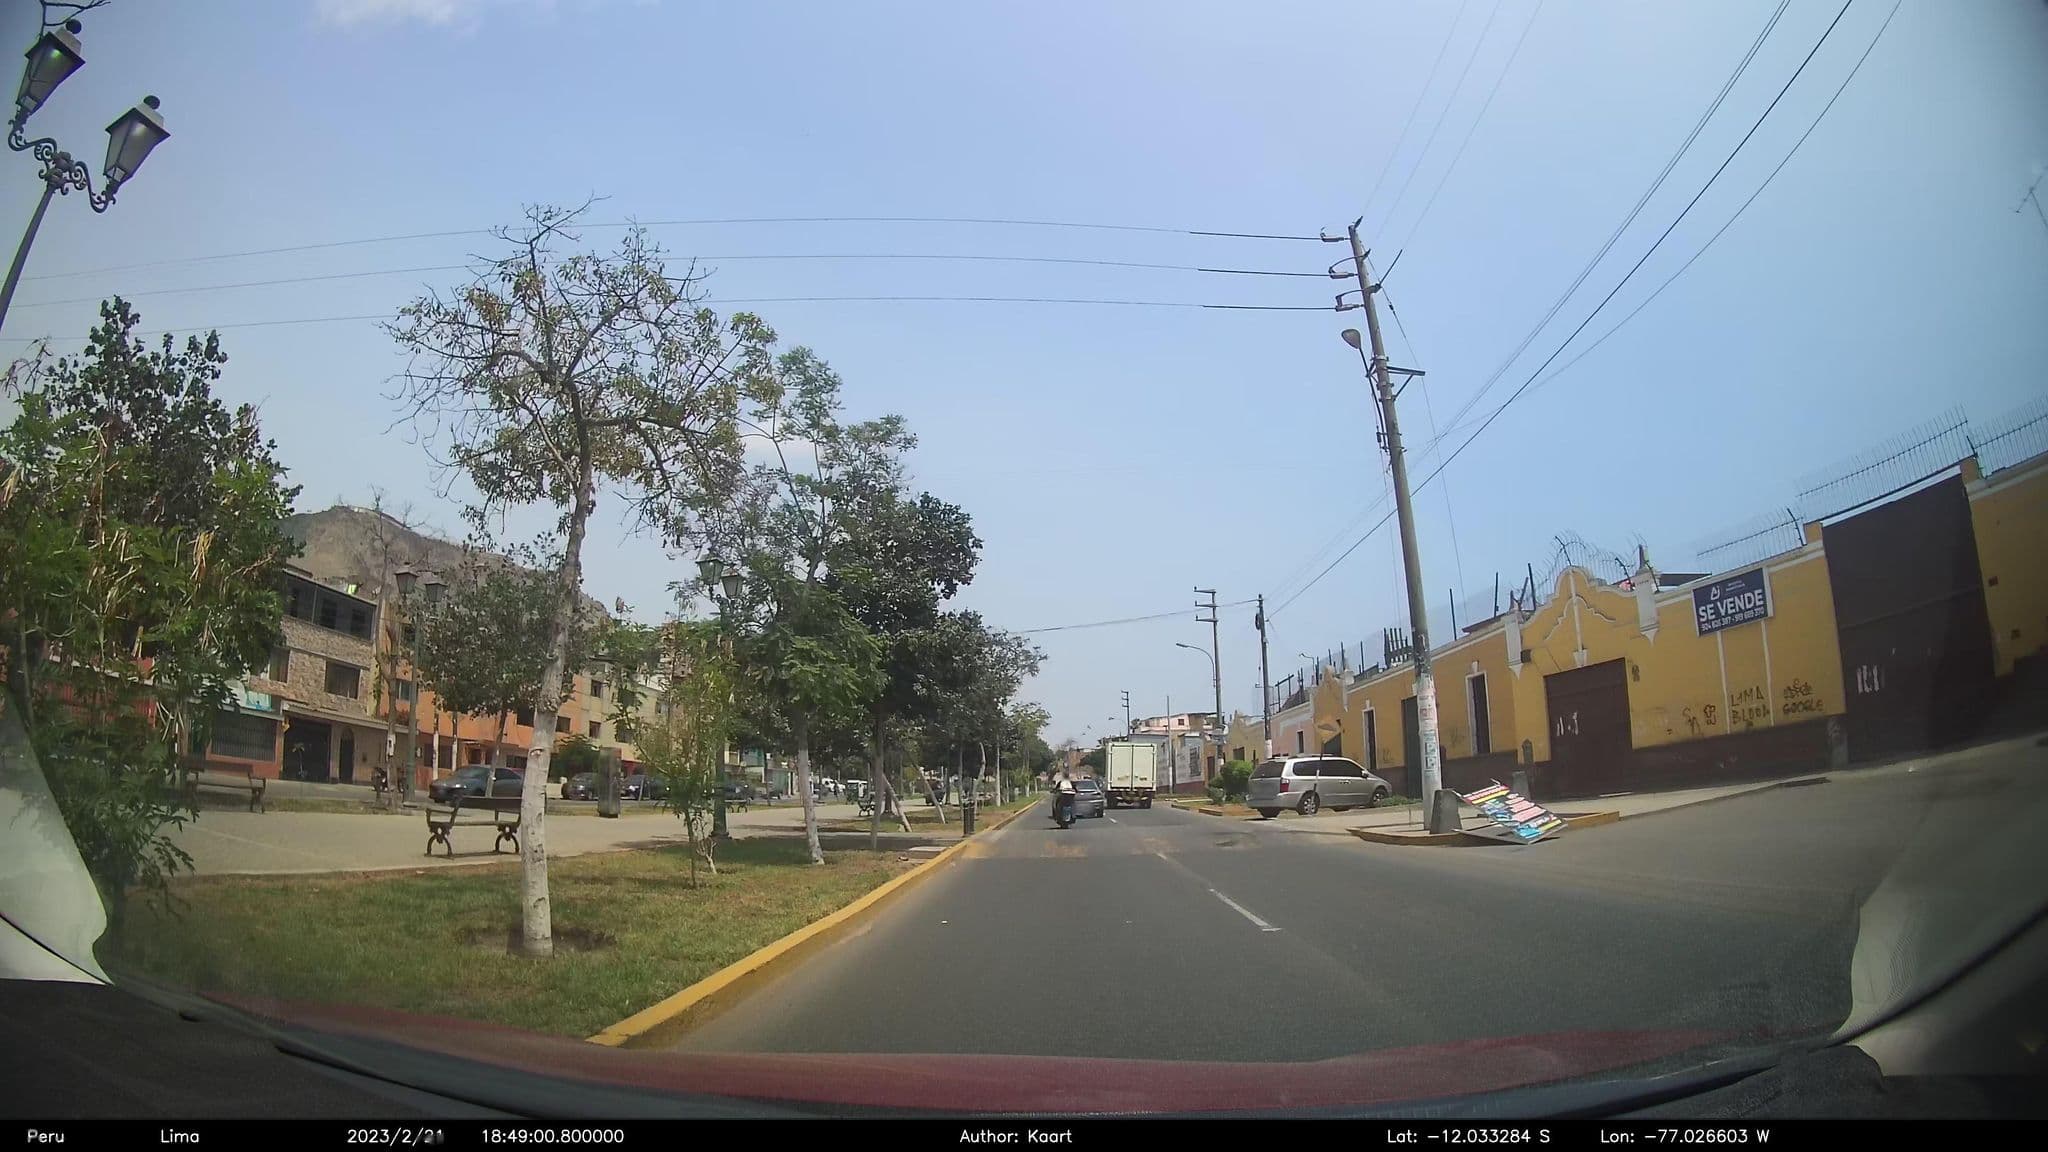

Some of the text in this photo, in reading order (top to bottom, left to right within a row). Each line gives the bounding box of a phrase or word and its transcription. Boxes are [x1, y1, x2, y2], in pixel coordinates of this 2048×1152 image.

[1698, 603, 1716, 622] SE
[1717, 589, 1764, 617] VENDE
[1730, 685, 1764, 707] LIMA
